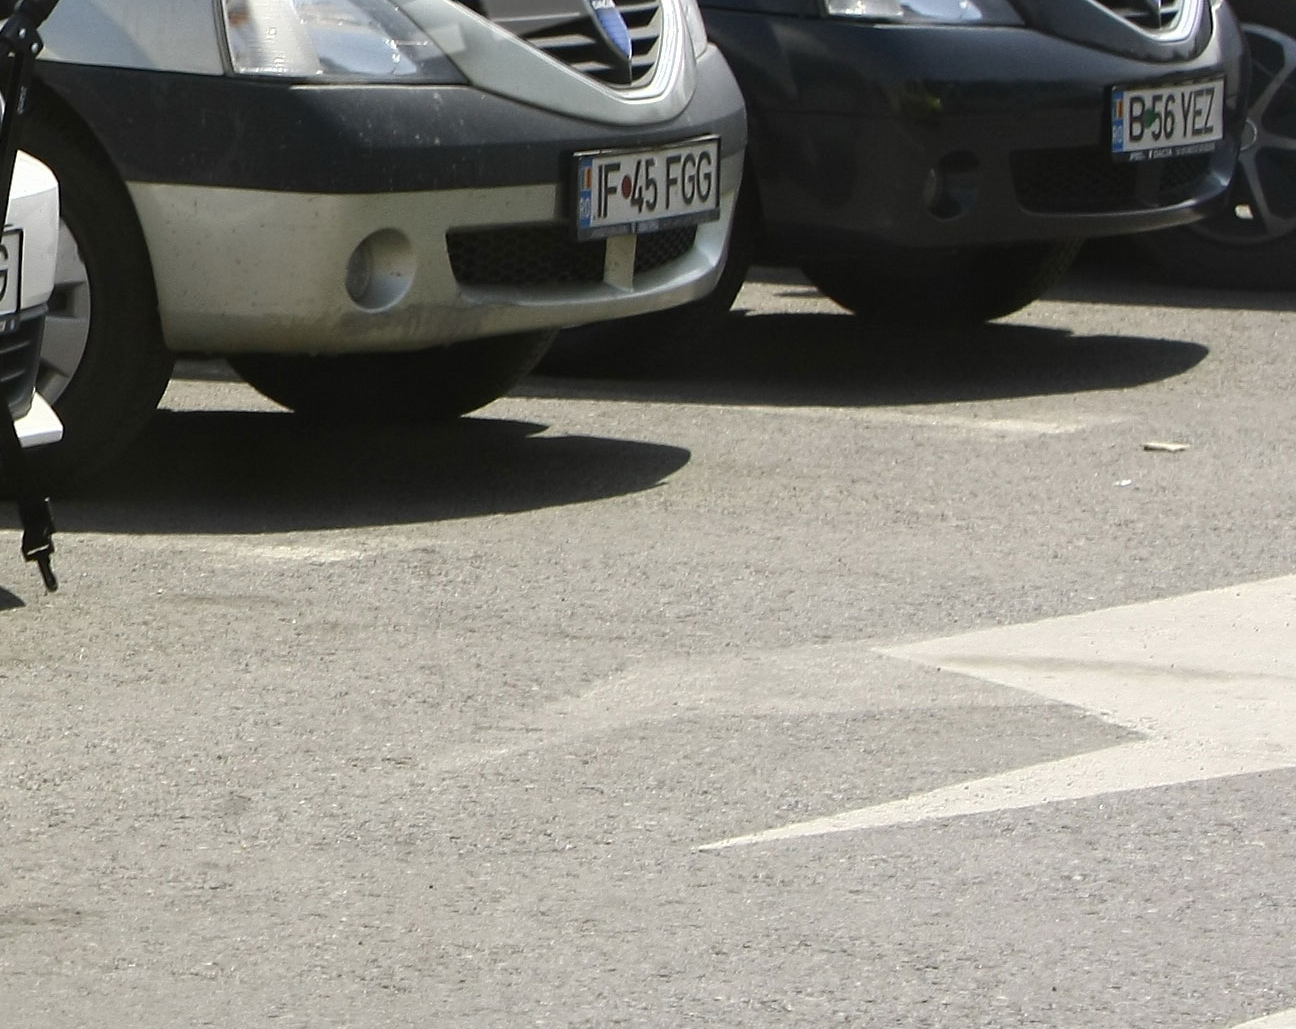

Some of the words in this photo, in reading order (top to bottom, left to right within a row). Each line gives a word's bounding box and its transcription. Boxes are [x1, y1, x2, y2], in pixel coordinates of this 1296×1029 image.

[1129, 96, 1145, 142] B
[1181, 87, 1215, 138] YEZ
[598, 163, 621, 218] IF
[630, 159, 658, 213] 45
[665, 151, 712, 210] FGG
